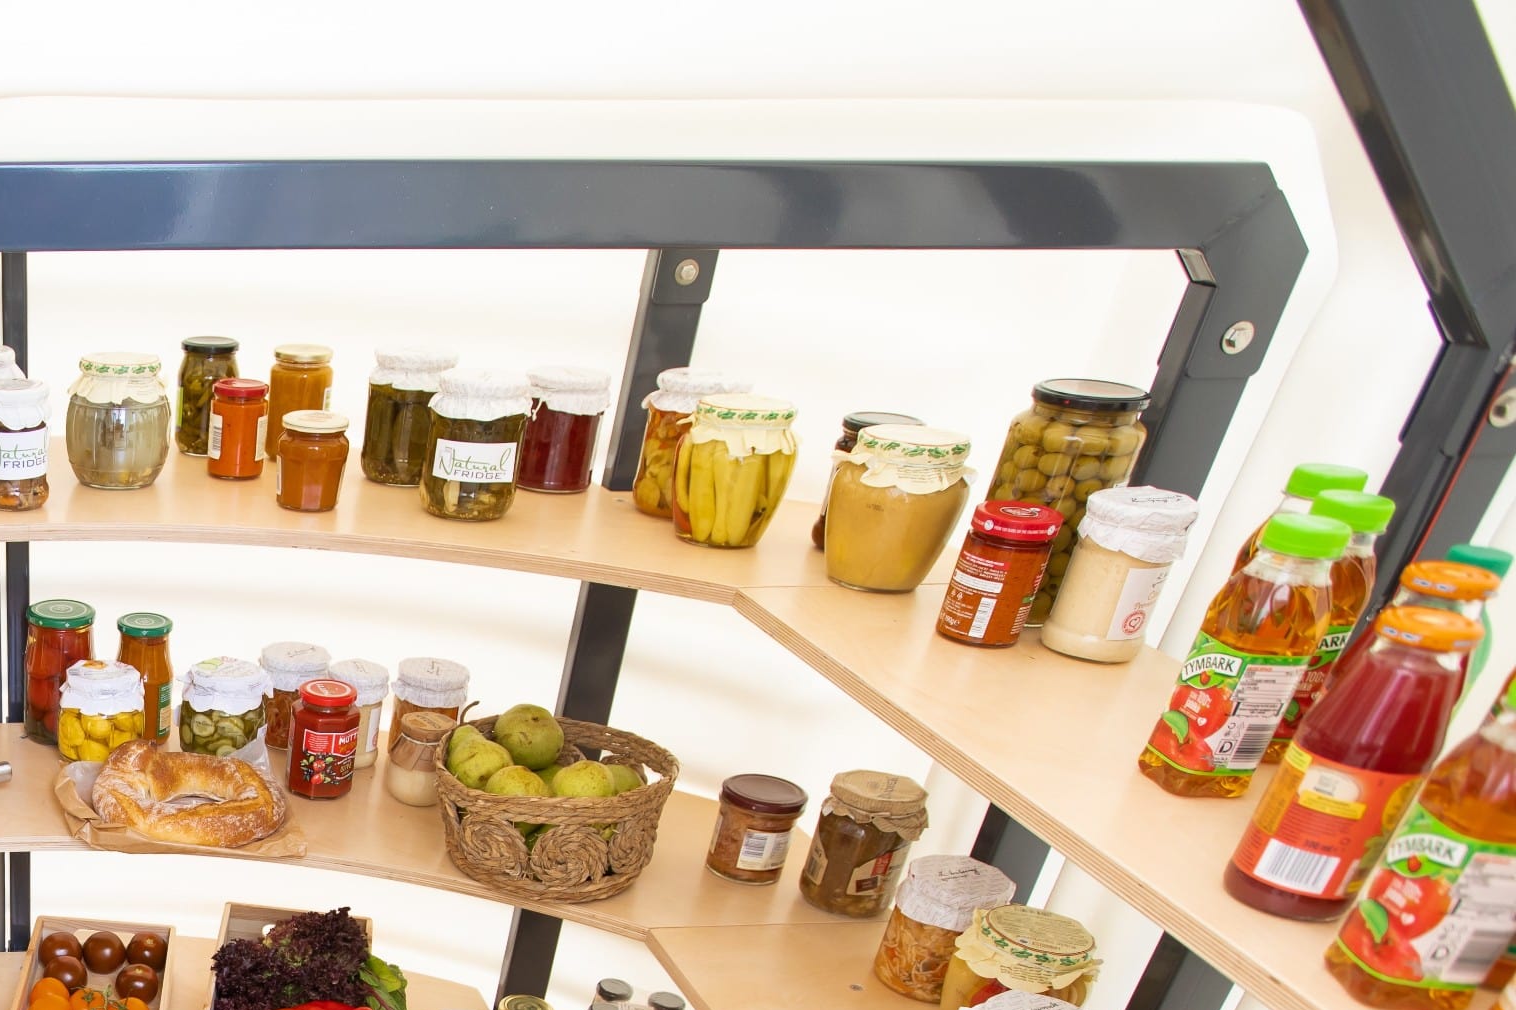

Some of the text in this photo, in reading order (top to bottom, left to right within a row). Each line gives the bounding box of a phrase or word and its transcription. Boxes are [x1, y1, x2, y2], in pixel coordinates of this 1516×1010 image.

[439, 447, 512, 475] Natural
[454, 469, 503, 480] FRIDGE
[1184, 655, 1236, 675] TYMBARK
[339, 733, 359, 746] MUTT
